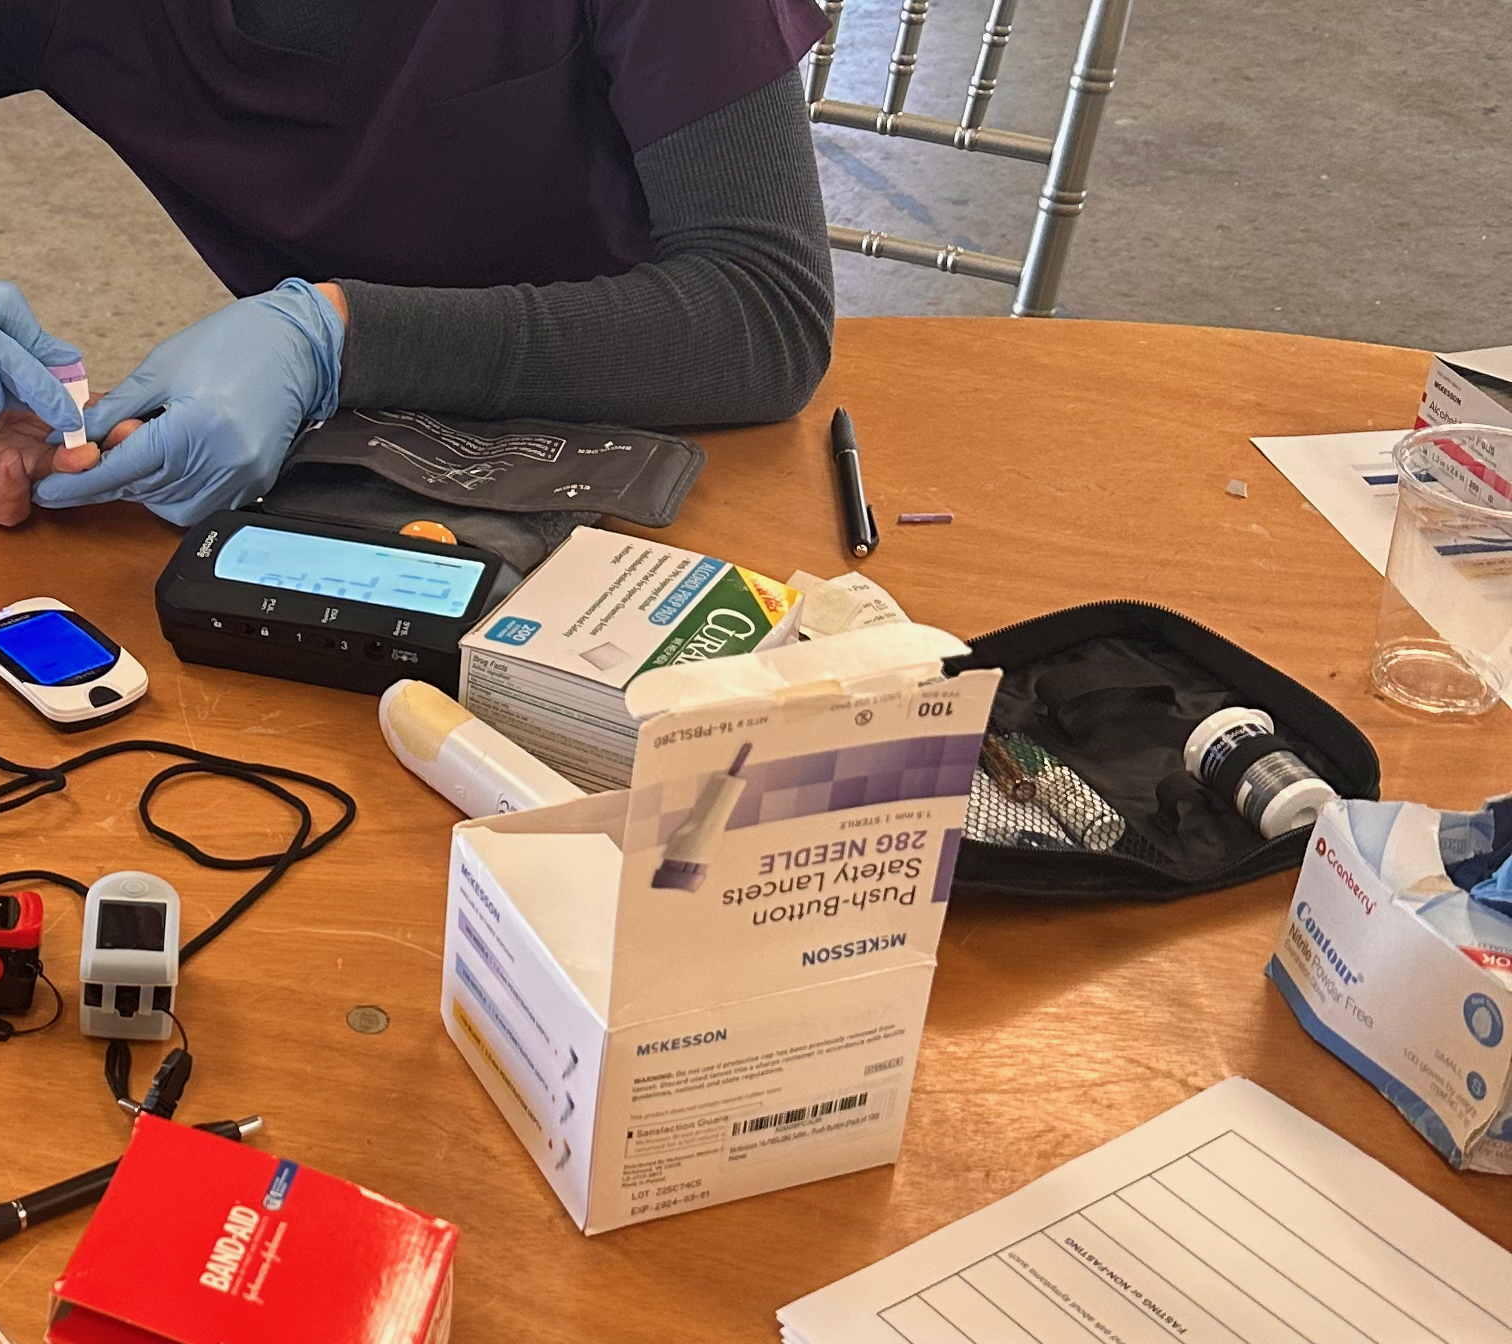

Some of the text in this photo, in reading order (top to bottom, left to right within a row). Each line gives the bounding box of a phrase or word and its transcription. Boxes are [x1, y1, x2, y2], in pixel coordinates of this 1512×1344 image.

[647, 561, 715, 624] ALCOHOL PREP PADS
[341, 641, 348, 651] 3
[511, 623, 536, 641] 200
[917, 700, 953, 717] 100
[839, 815, 881, 830] STERILE
[758, 829, 927, 875] 28G NEEDLE
[721, 856, 922, 905] Safety Lancets
[1326, 848, 1373, 915] Cranberry
[752, 885, 916, 925] Push-Button
[1296, 901, 1358, 984] Contour
[1288, 921, 1313, 964] Nitrile
[1312, 957, 1345, 1004] Powder
[1343, 995, 1374, 1029] Free
[635, 1121, 695, 1138] Satisfaction
[200, 1206, 258, 1290] BAND-AID
[1064, 1236, 1131, 1290] NON-FASTING
[1141, 1297, 1187, 1334] FASTING
